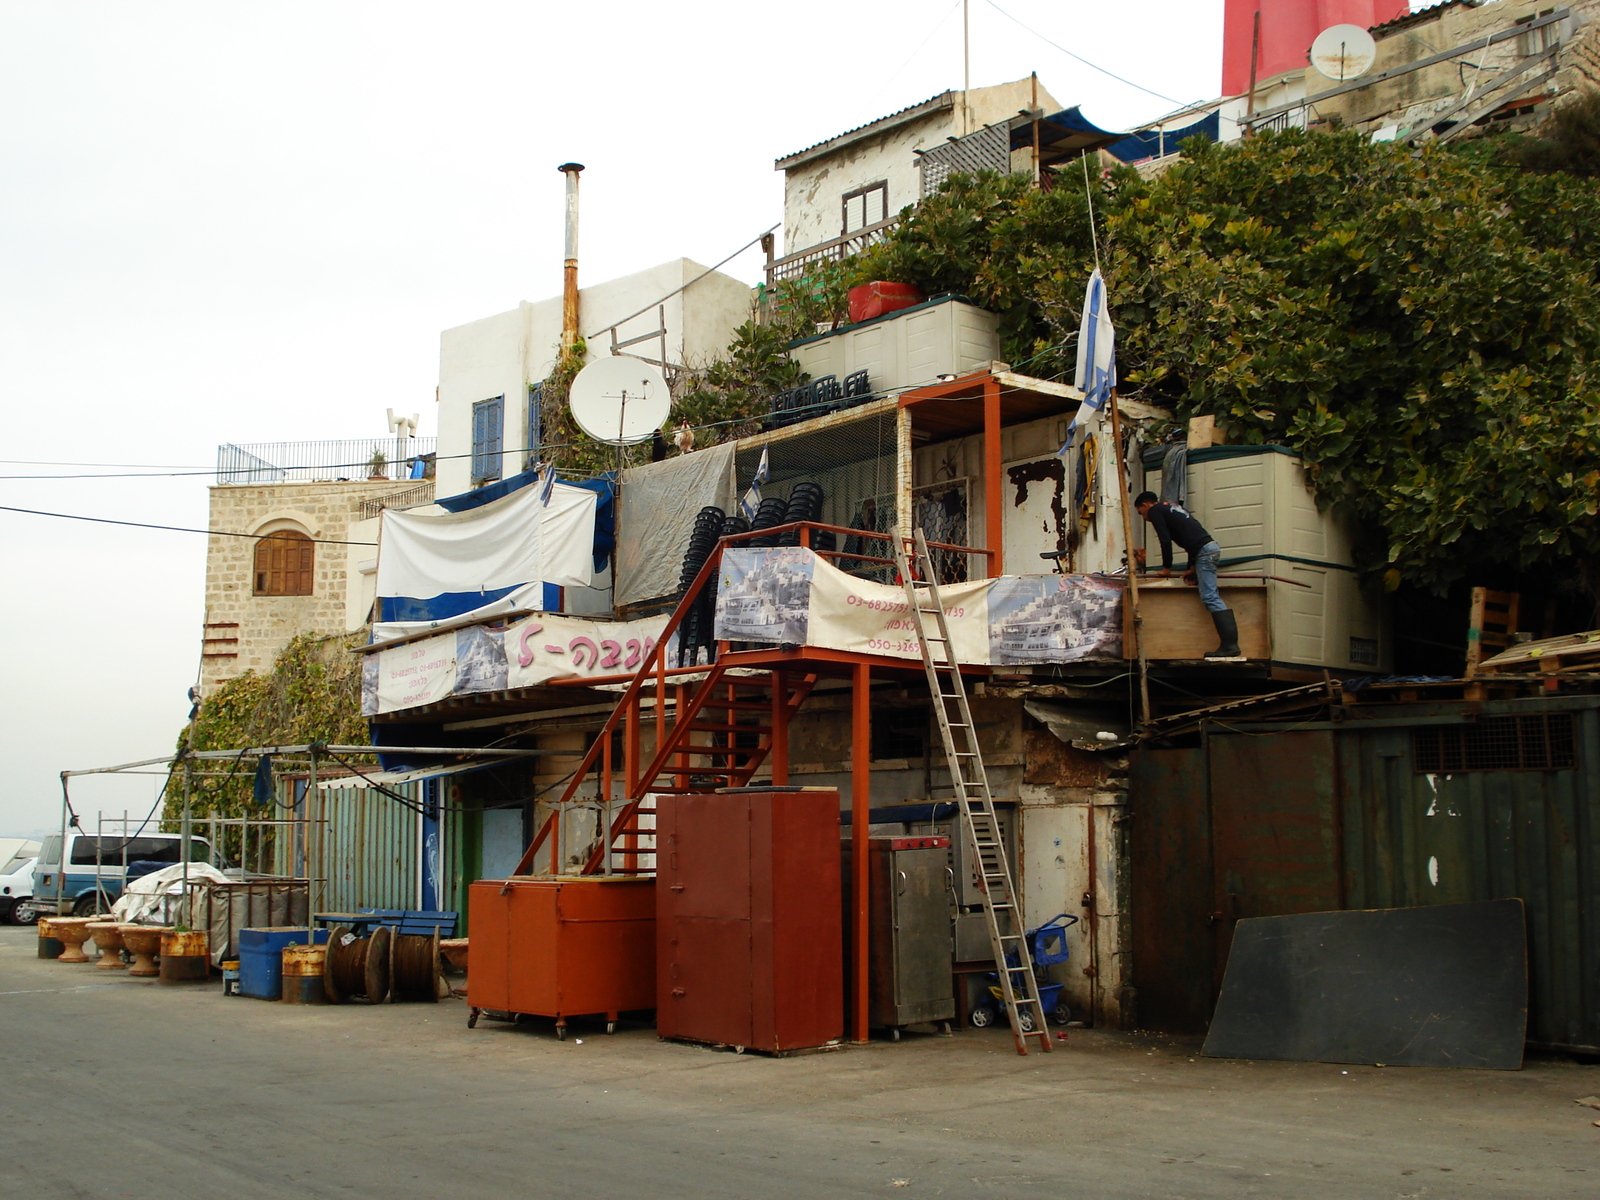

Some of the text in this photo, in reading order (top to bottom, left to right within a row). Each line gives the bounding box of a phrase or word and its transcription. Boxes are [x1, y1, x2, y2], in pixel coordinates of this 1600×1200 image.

[846, 595, 909, 614] 03-6825753,
[884, 616, 916, 631] לאפון:
[868, 638, 920, 653] 050-3265
